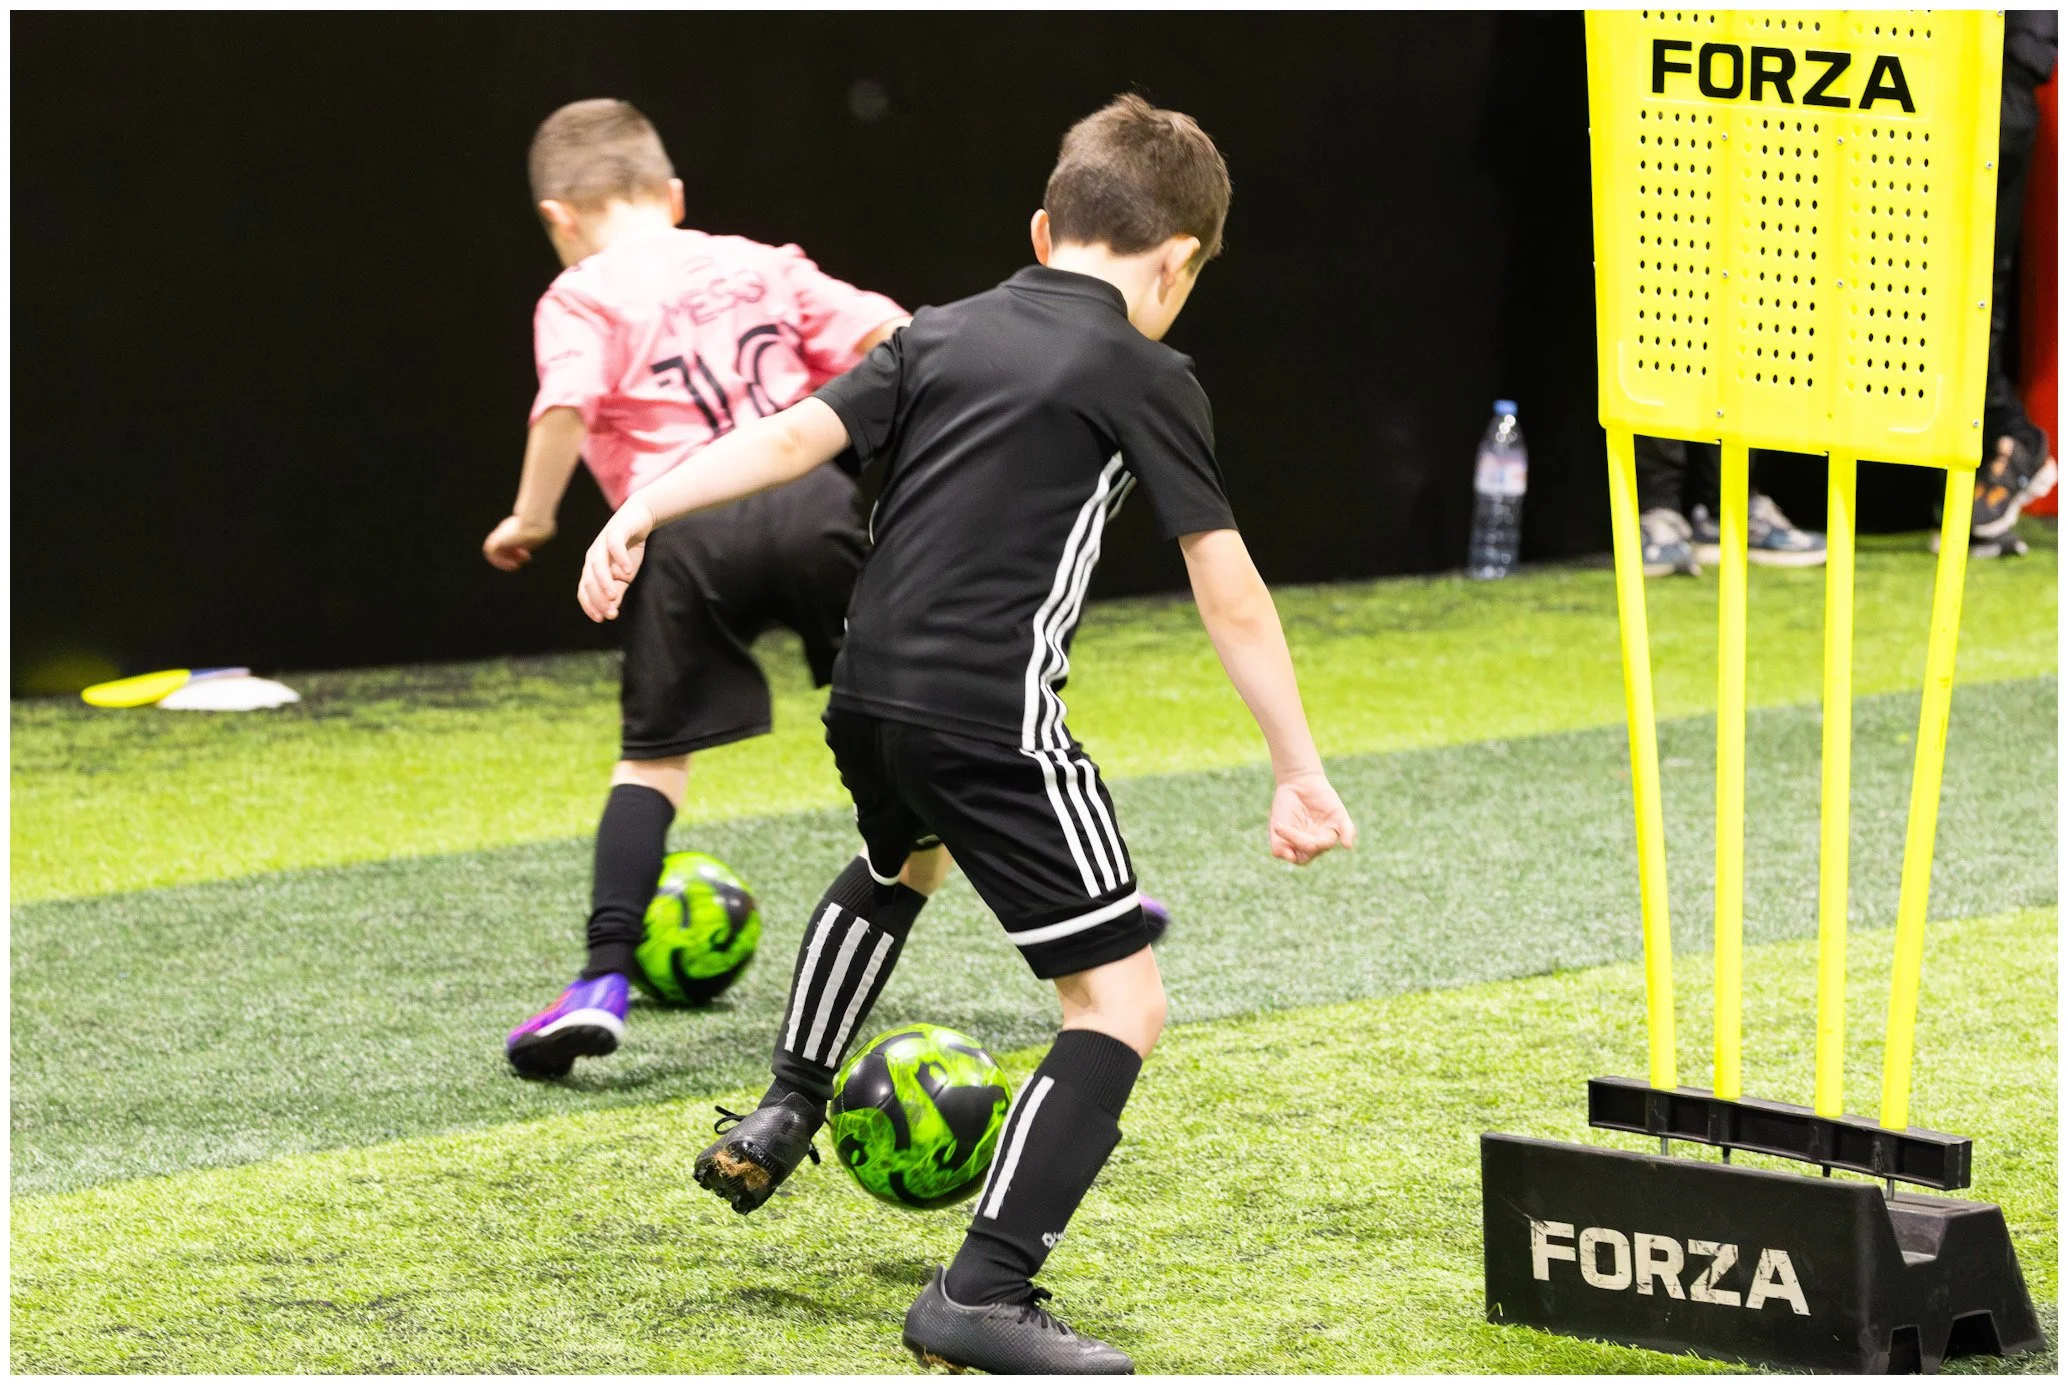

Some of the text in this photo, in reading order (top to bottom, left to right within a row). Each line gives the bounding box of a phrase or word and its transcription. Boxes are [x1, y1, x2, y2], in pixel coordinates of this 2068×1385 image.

[1652, 38, 1916, 113] FORZA
[651, 319, 806, 436] 10
[1530, 1220, 1811, 1316] FORZA
